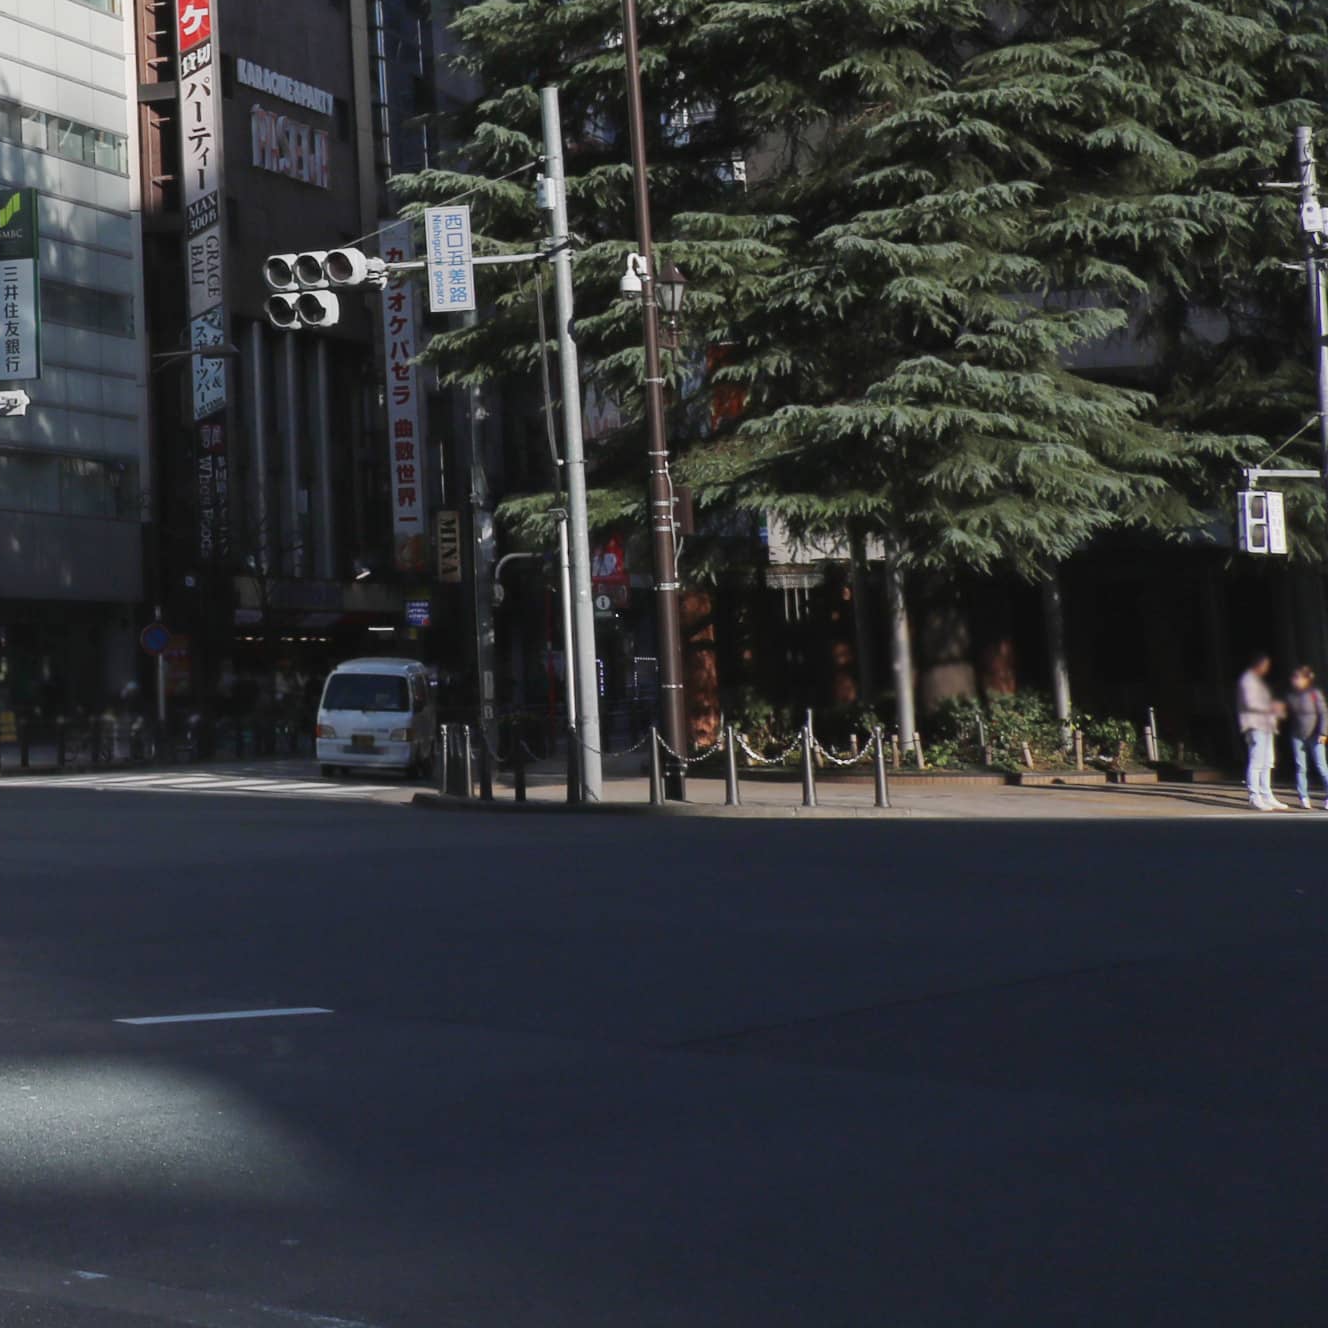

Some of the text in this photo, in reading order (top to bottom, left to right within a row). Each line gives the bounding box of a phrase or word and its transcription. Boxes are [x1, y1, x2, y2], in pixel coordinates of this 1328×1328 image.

[182, 43, 211, 76] 貸切
[186, 76, 211, 190] パーティー
[188, 192, 217, 219] MAX
[192, 245, 204, 285] BALI
[206, 235, 222, 298] GRACE
[434, 271, 445, 305] gosaro
[445, 213, 467, 303] 西口五差路
[3, 266, 21, 373] 三井住友銀行
[395, 419, 417, 522] 曲数世界一
[440, 518, 459, 576] MINA
